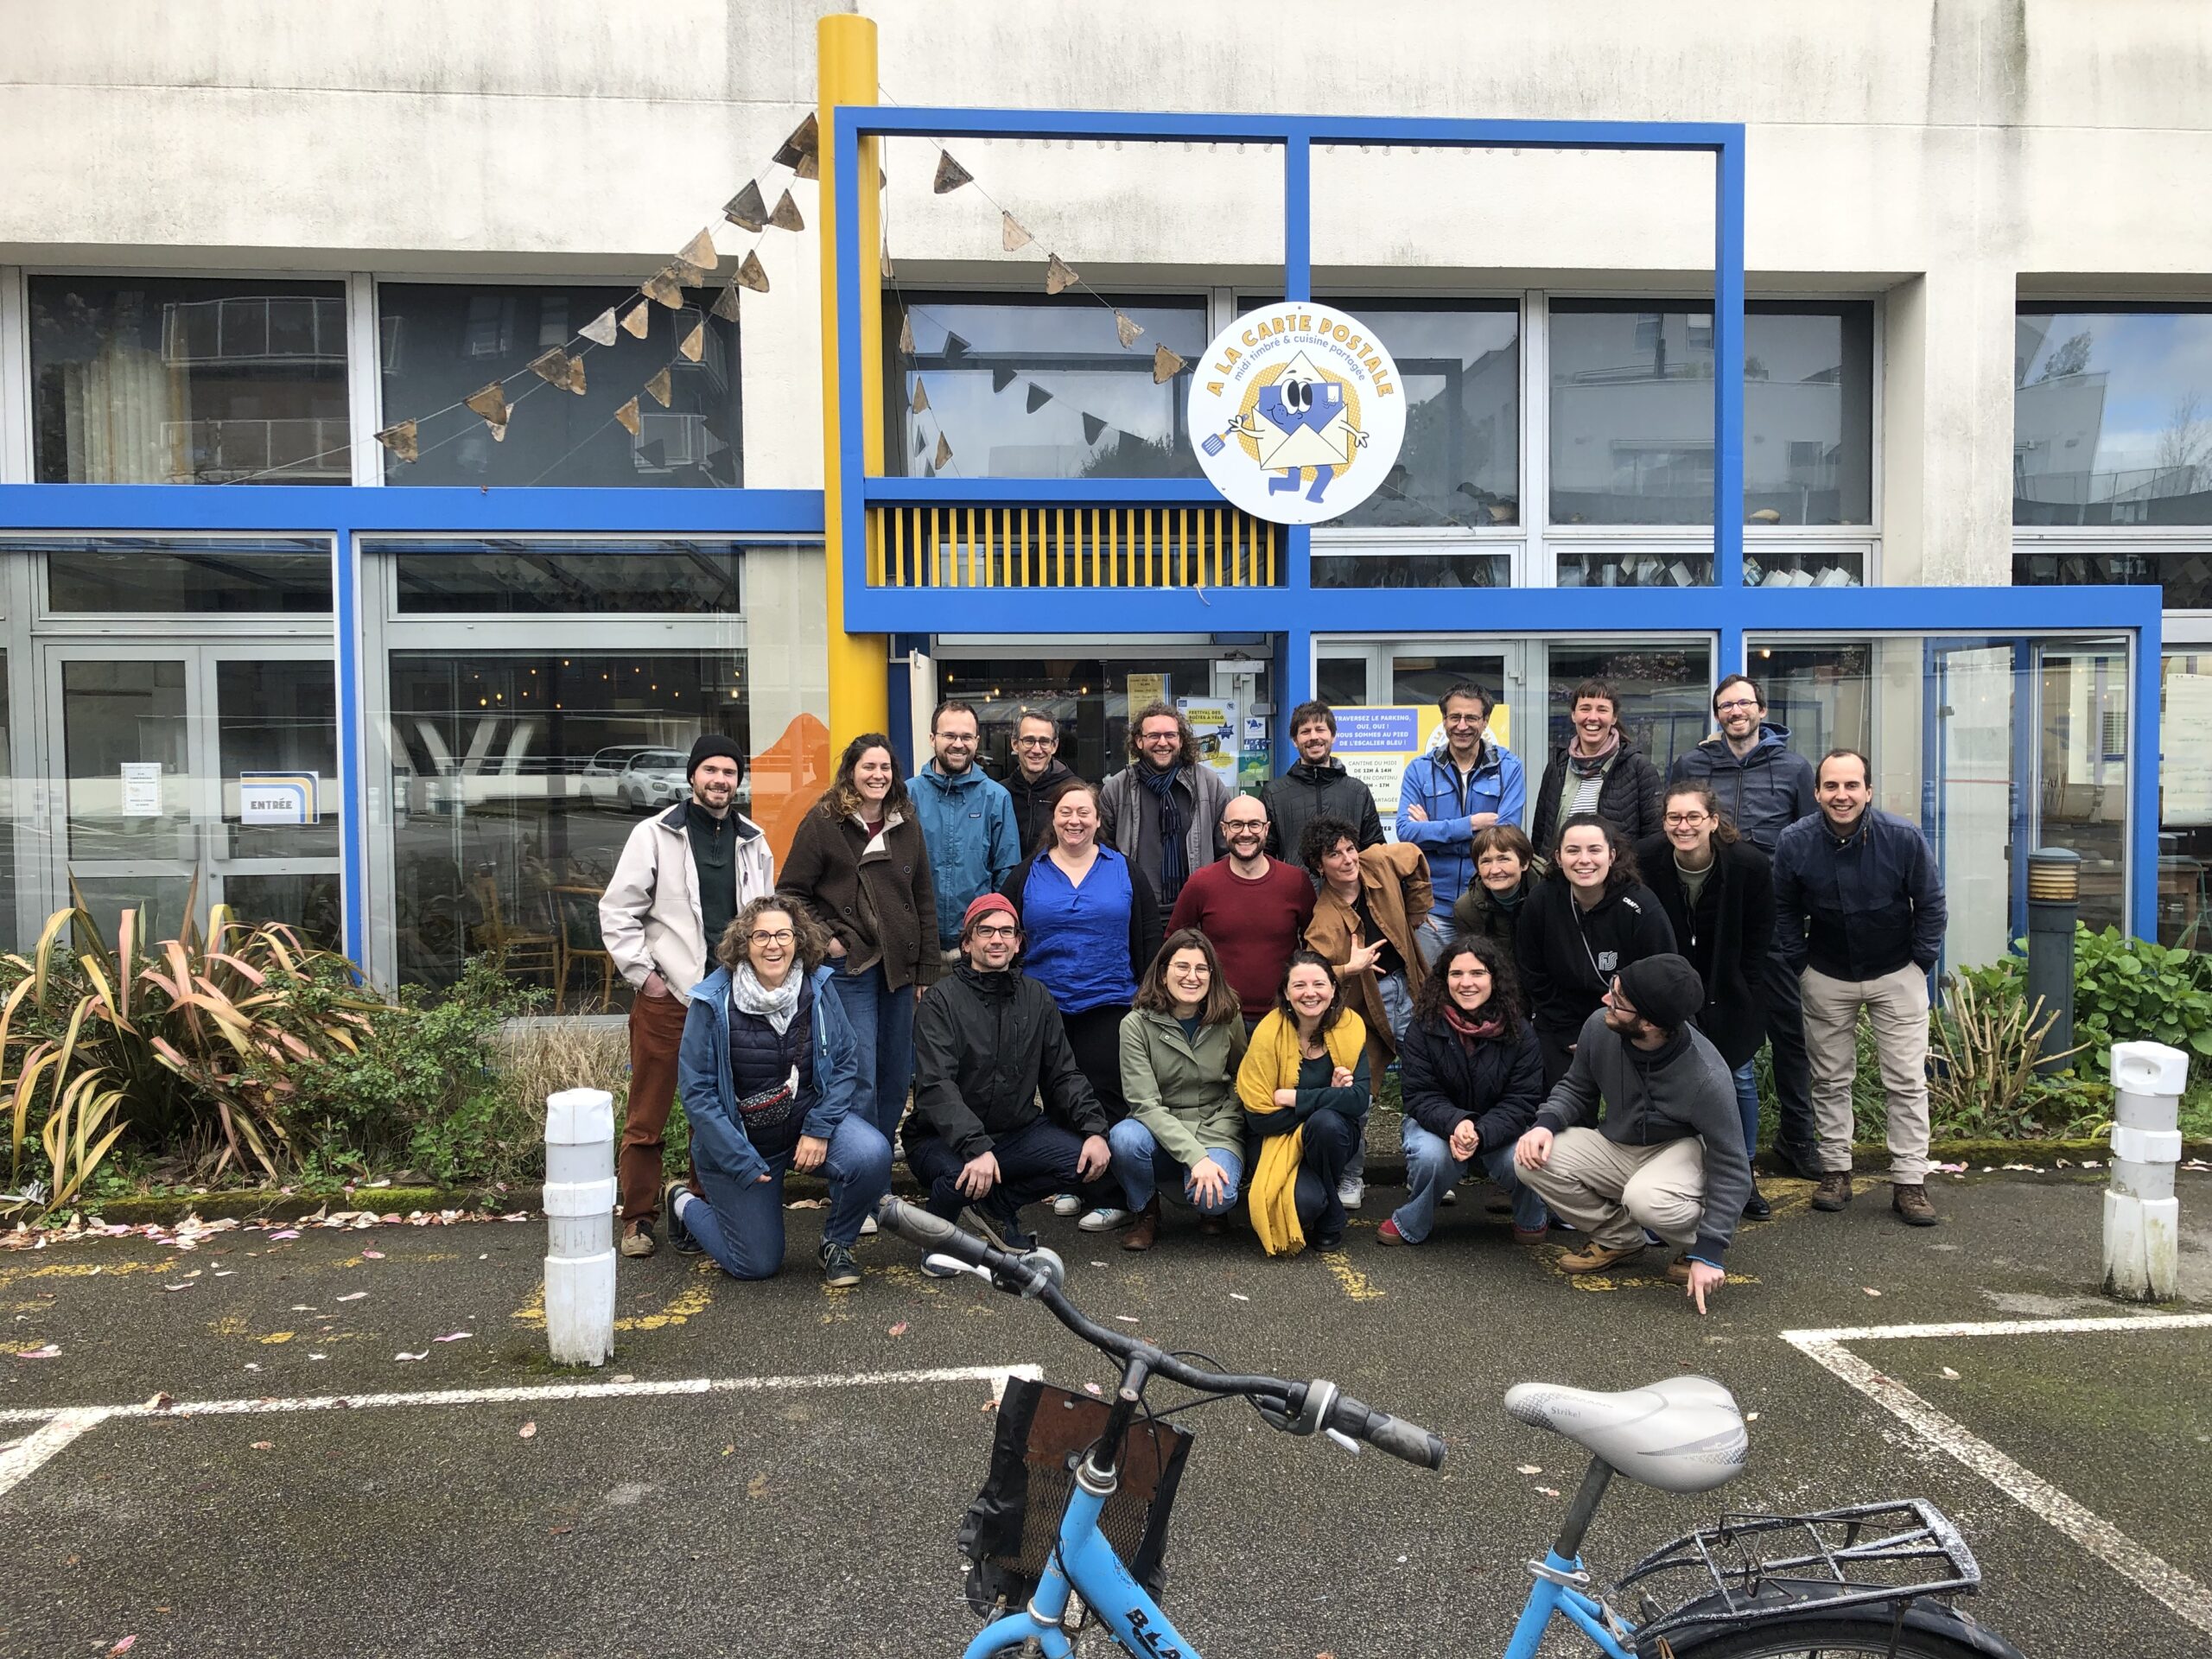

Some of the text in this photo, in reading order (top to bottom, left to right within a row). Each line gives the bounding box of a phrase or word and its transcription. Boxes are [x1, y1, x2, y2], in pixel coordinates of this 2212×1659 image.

[1206, 315, 1394, 397] A LA CARTE POSTALE
[1235, 334, 1365, 381] midi timbré & cuisine partagée
[250, 797, 294, 810] ENTRÉE
